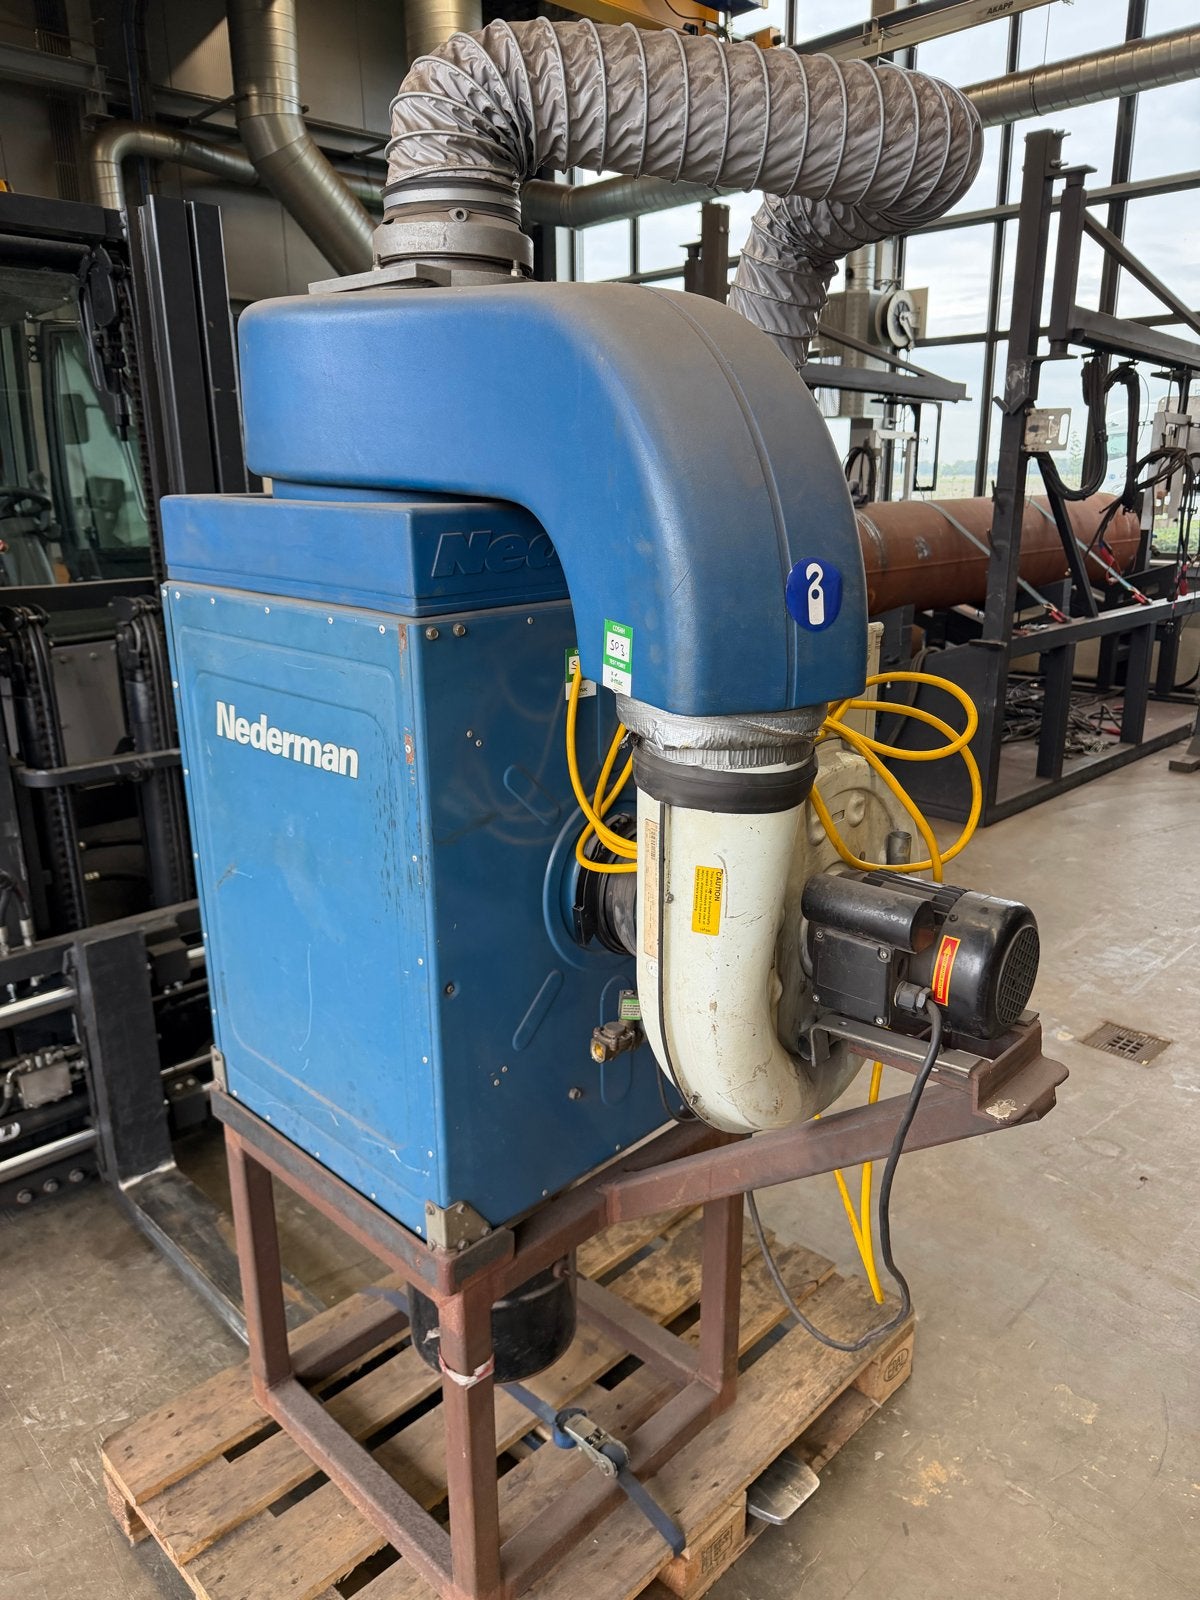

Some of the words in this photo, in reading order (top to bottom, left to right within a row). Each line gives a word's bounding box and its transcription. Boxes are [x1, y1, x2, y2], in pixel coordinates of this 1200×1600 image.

[986, 0, 1014, 14] AKAPP
[216, 700, 359, 779] Nederman
[714, 871, 722, 902] CAUTION
